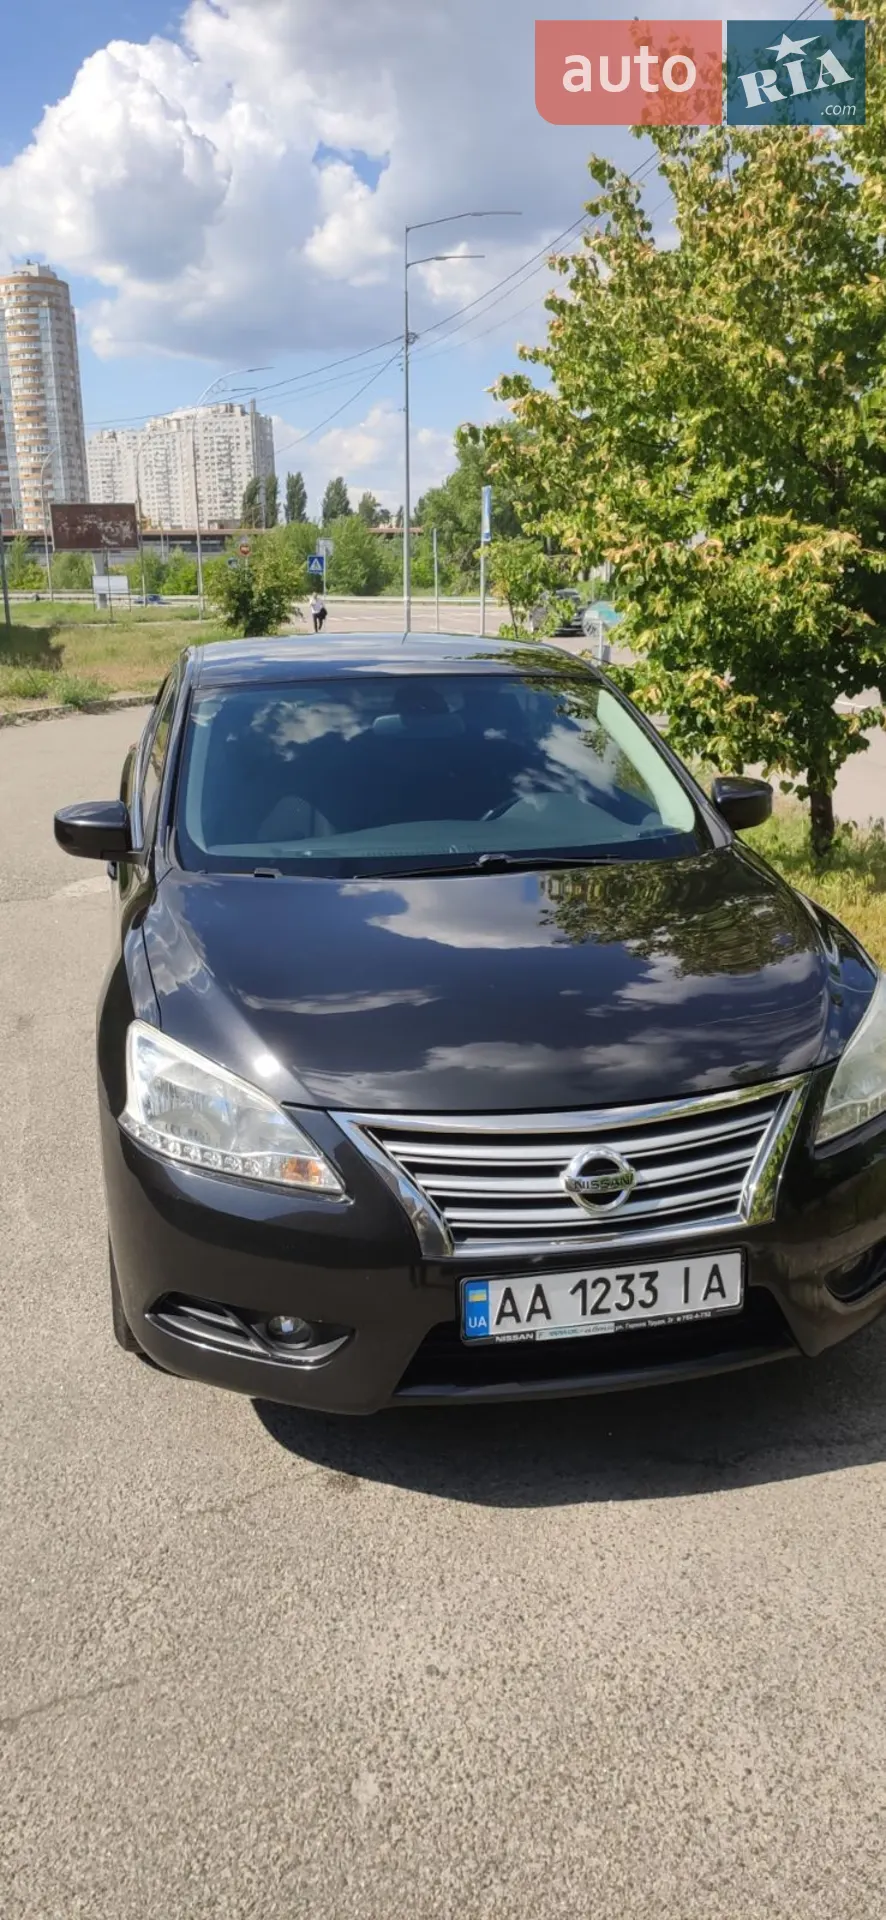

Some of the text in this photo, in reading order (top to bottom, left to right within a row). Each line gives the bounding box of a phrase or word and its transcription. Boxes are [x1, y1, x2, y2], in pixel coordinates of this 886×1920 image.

[573, 1172, 634, 1190] NISSAN
[495, 1283, 552, 1326] AA
[569, 1270, 659, 1317] 1233
[468, 1315, 487, 1329] UA
[495, 1332, 534, 1342] NISSAN
